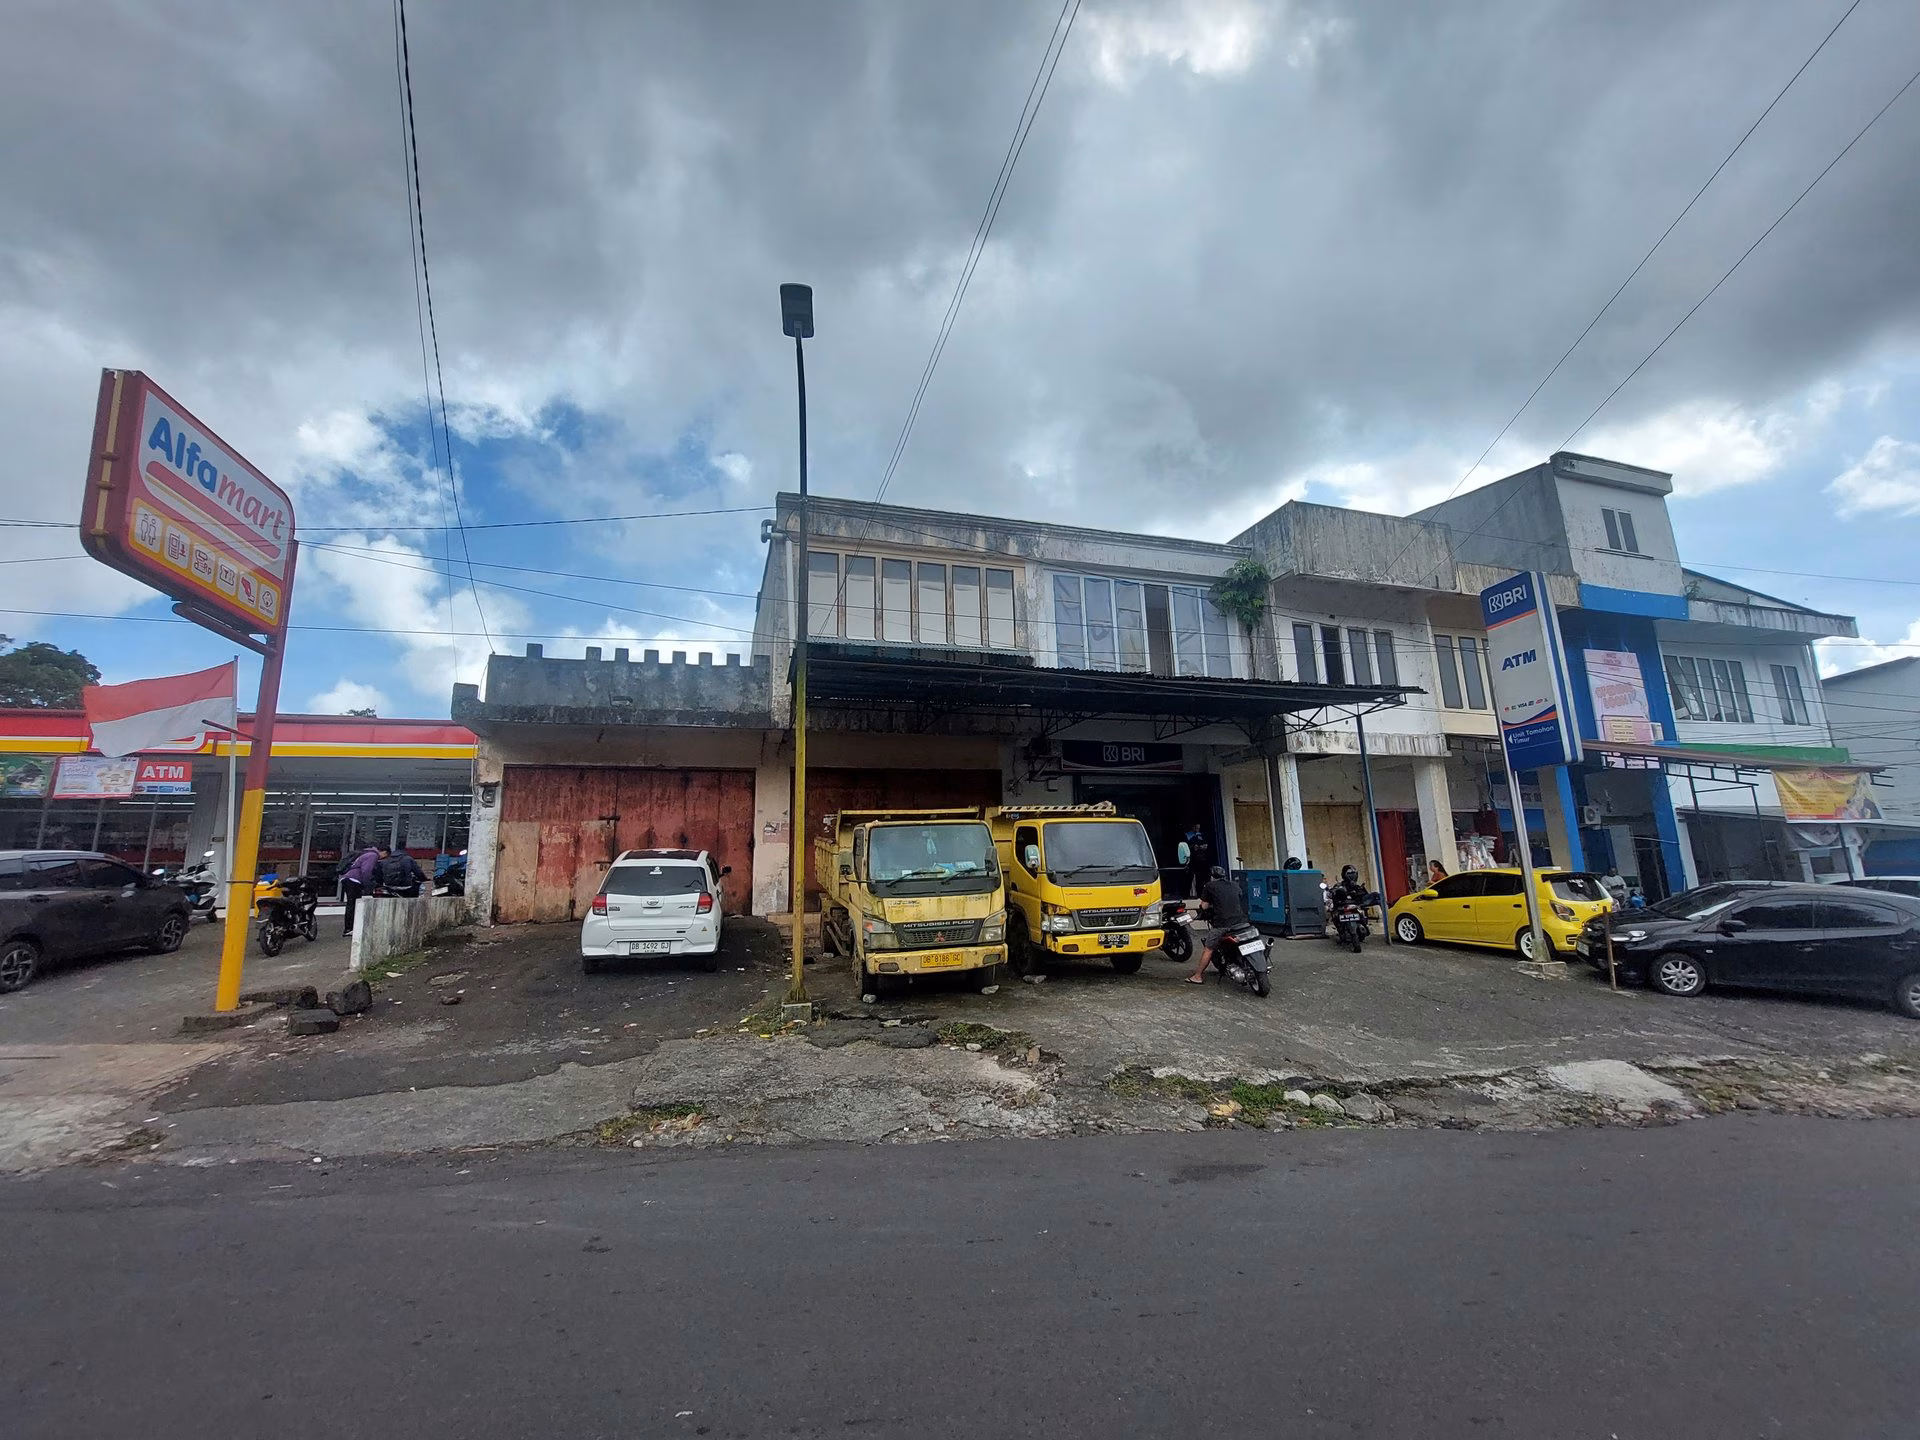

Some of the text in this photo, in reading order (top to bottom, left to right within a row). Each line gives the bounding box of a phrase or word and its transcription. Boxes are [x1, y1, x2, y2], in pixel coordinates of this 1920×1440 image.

[148, 416, 286, 541] Alfamart
[1502, 584, 1528, 606] BRI
[1502, 649, 1537, 671] ATM
[1512, 725, 1555, 739] Unit Tomohon
[1121, 746, 1145, 762] BRI
[141, 765, 184, 779] ATM
[903, 921, 951, 929] MITSUBISHI
[642, 942, 658, 950] 1492
